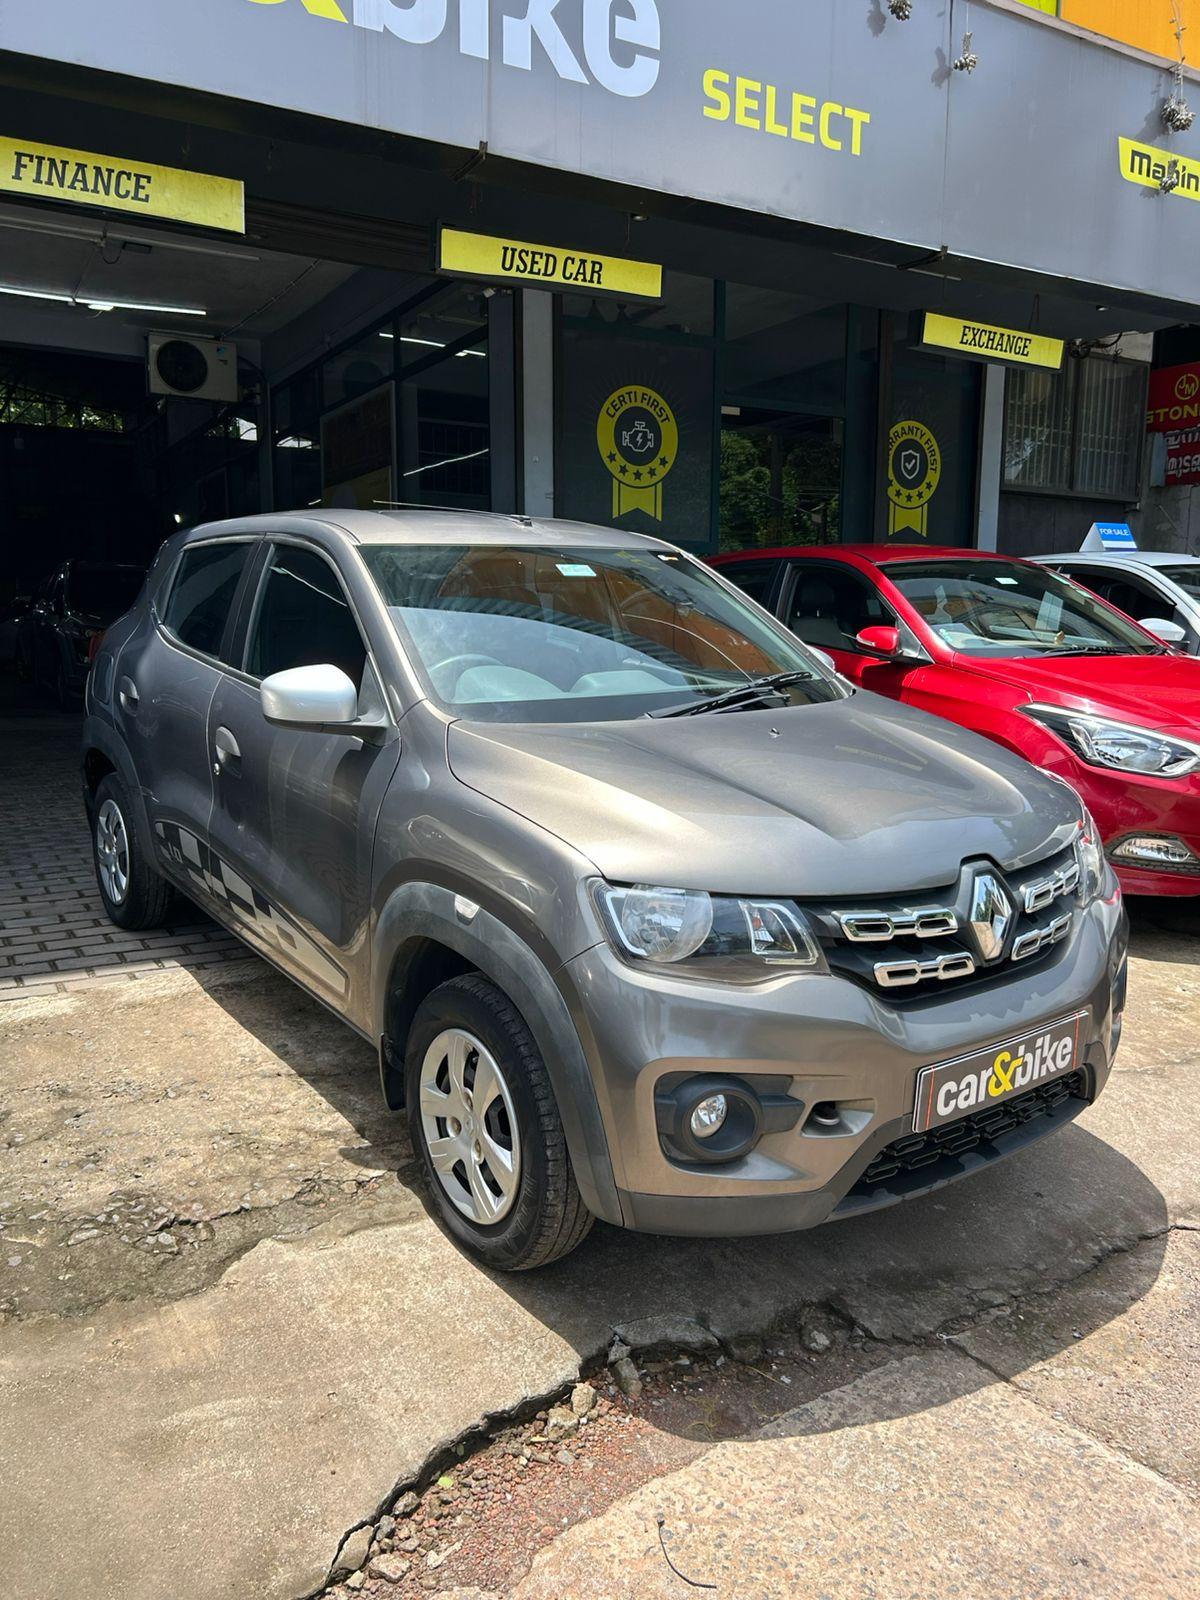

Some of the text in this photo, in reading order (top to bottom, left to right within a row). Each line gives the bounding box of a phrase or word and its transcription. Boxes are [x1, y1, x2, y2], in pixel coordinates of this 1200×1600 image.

[703, 69, 870, 156] SELECT
[12, 151, 152, 203] FINANCE
[501, 246, 604, 285] USED CAR
[959, 325, 1032, 357] EXCHANGE
[605, 391, 671, 423] CERTI FIRST
[1146, 403, 1200, 424] STON
[923, 437, 938, 474] FIRST
[936, 1034, 1073, 1117] car&bike
